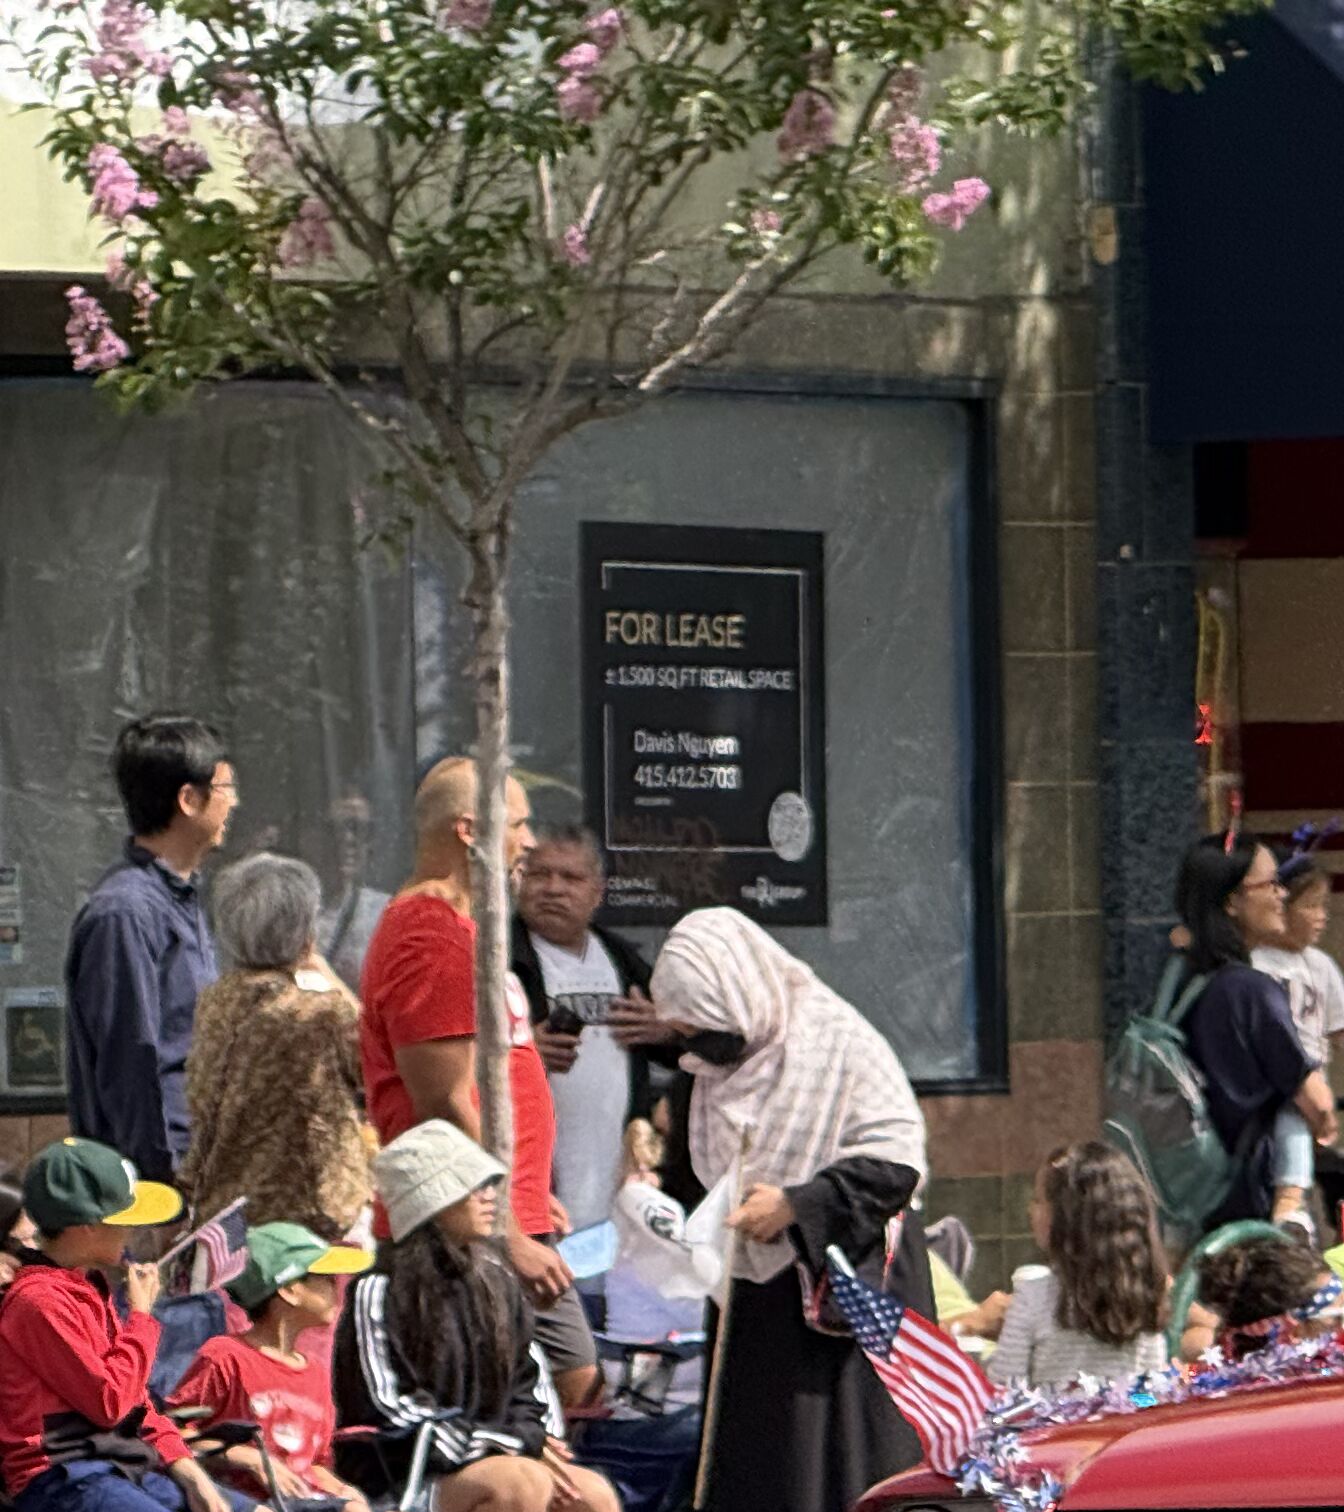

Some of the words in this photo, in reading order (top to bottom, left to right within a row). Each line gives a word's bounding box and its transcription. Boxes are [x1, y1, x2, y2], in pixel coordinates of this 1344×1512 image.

[605, 611, 657, 646] FOR
[664, 614, 746, 649] LEASE
[700, 668, 747, 690] RETAIL
[748, 670, 795, 692] SPACE
[634, 729, 674, 755] Davis
